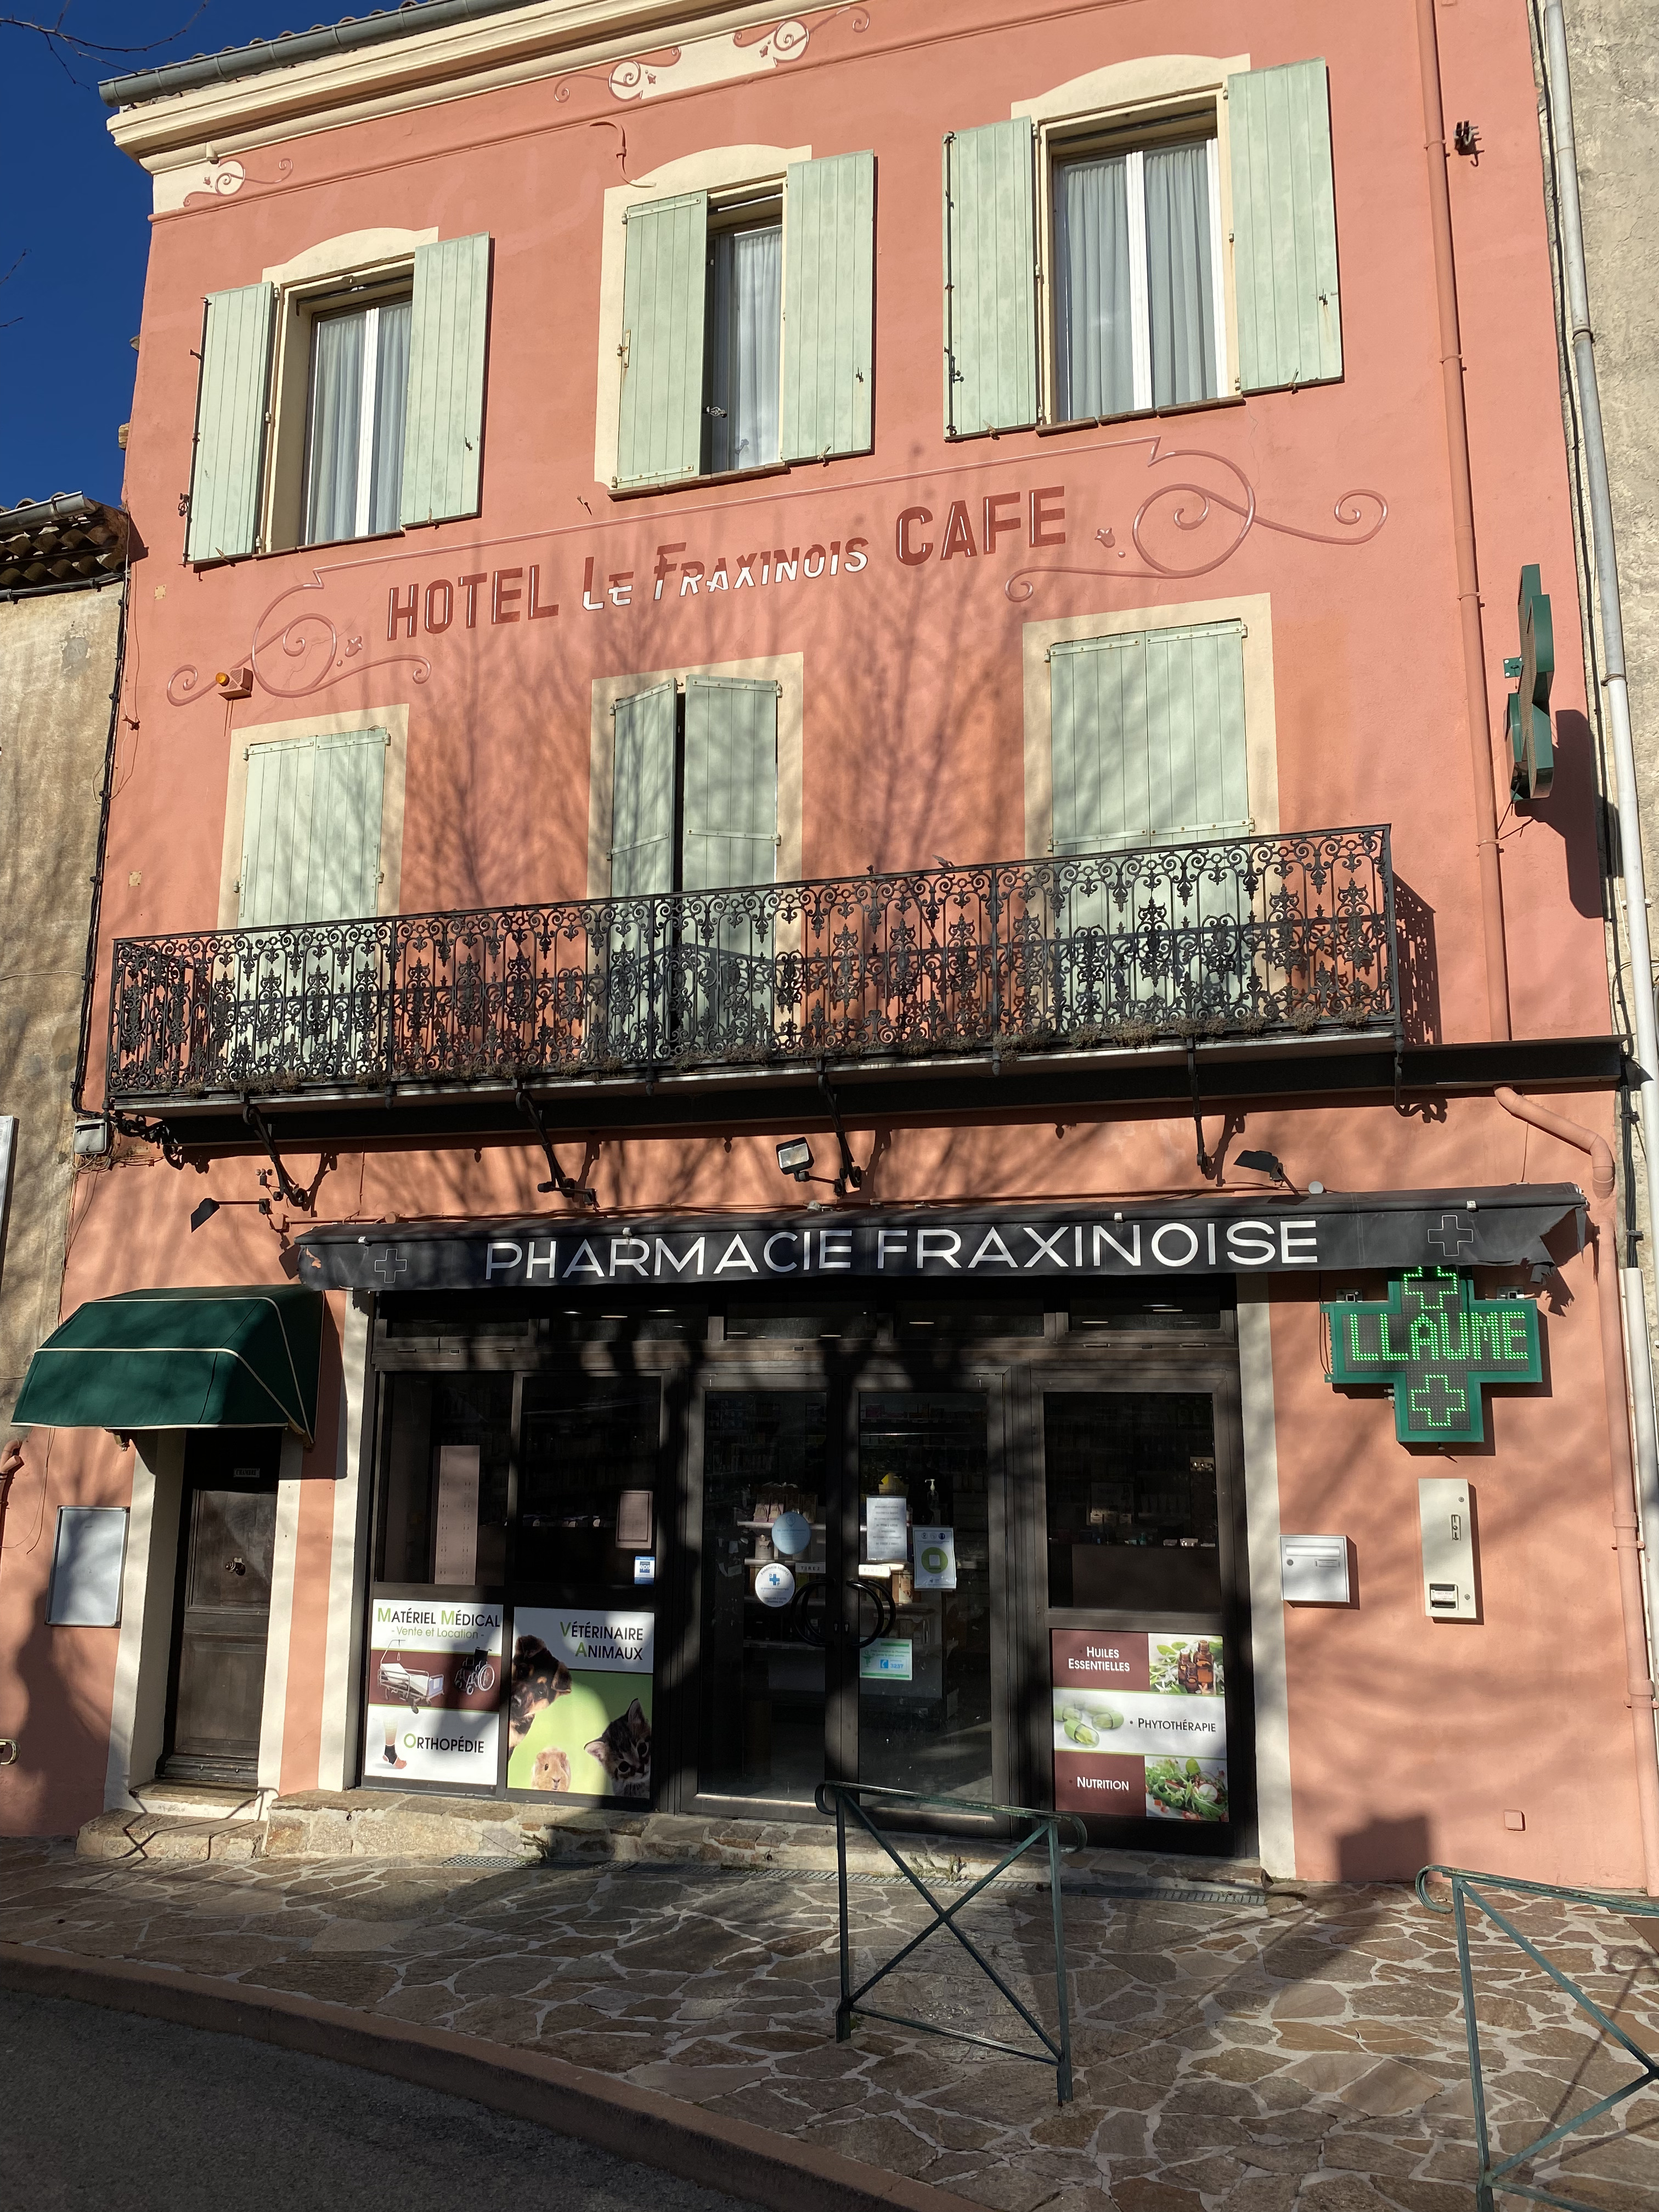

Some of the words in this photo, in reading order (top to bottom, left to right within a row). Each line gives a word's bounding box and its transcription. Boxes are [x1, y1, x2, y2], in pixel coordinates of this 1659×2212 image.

[387, 564, 559, 641] HOTEL
[583, 556, 634, 611] LE
[653, 537, 870, 601] FRAXINOIS
[895, 486, 1066, 566] CAFE
[485, 1229, 853, 1280] PHARMACIE
[877, 1220, 1318, 1269] FRAXINOISE
[1349, 1311, 1529, 1361] LLAUME
[377, 1607, 436, 1624] MATÉRIEL
[441, 1610, 500, 1627] MÉDICAL
[396, 1626, 423, 1637] Vente
[425, 1627, 435, 1637] et
[438, 1627, 478, 1639] Location
[560, 1621, 643, 1641] VÉTÉRINAIRE
[575, 1642, 643, 1660] ANIMAUX
[1086, 1646, 1120, 1658] HUILES
[1068, 1658, 1130, 1672] ESSENTIELLES
[1138, 1717, 1216, 1733] PHYTOTHÉRAPIE
[404, 1733, 484, 1753] ORTHOPÉDIE
[1076, 1776, 1130, 1791] NUTRITION
